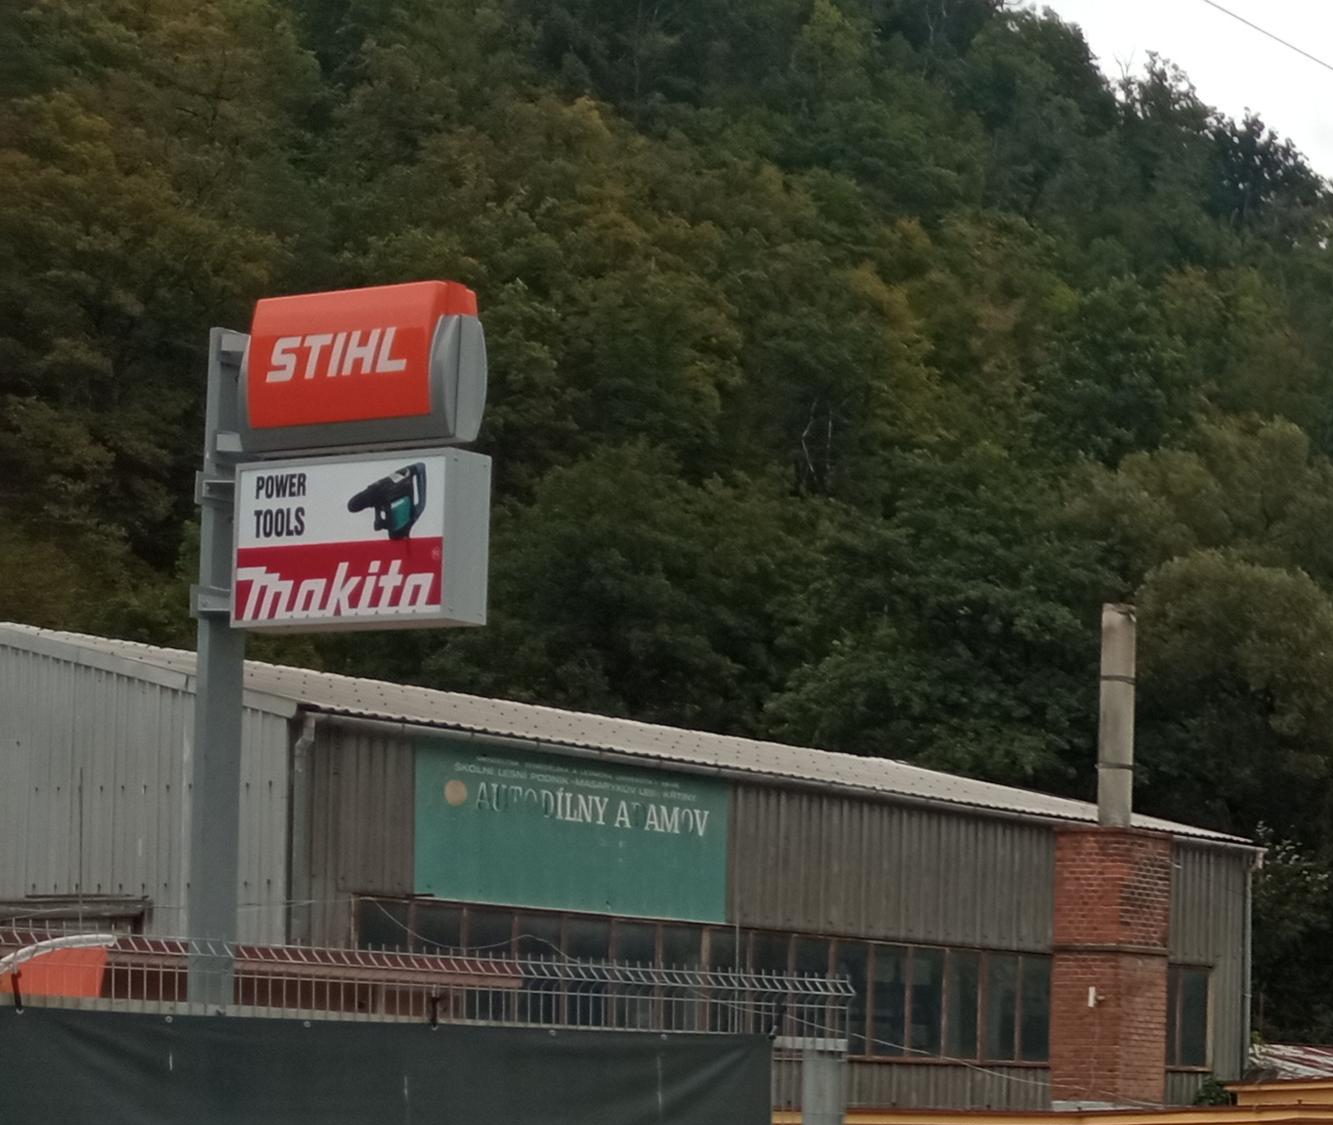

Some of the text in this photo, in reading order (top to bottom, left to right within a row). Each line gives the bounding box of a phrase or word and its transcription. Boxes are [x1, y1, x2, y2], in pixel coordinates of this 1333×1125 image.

[265, 326, 407, 383] STIHL
[255, 473, 307, 499] POWER
[254, 506, 306, 538] TOOLS
